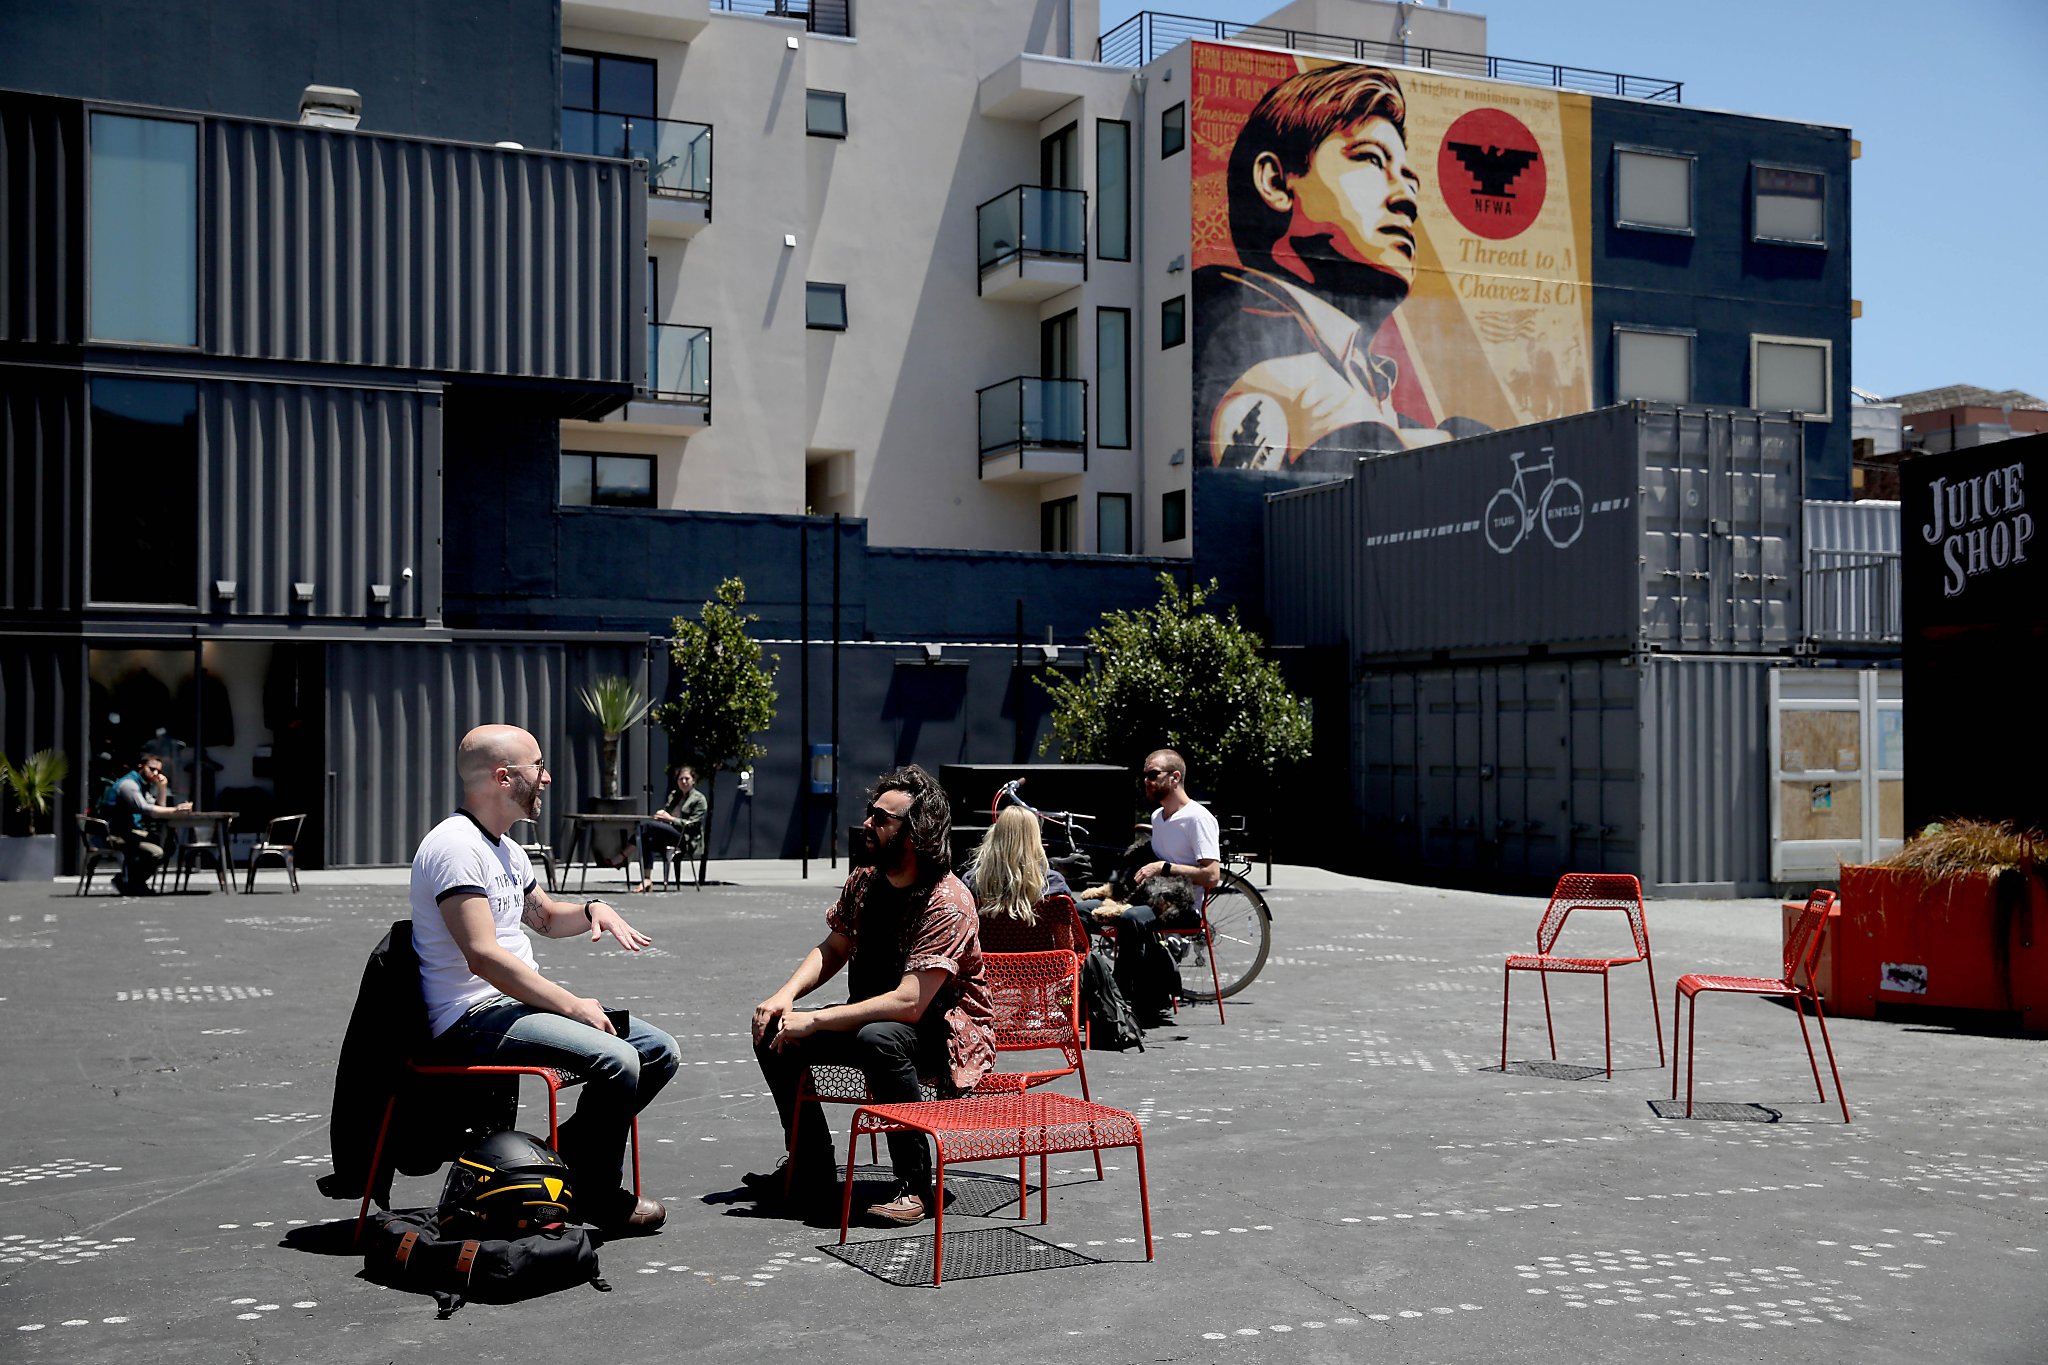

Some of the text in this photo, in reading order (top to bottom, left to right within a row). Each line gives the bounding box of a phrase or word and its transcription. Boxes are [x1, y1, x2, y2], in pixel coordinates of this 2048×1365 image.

[1192, 46, 1220, 72] FARM
[1222, 50, 1253, 76] BOARD
[1198, 73, 1210, 96] TO
[1215, 77, 1231, 99] FIX
[1408, 78, 1417, 93] A
[1420, 81, 1459, 98] higher
[1464, 87, 1520, 106] minimum
[1192, 95, 1250, 125] American
[1475, 198, 1512, 215] NFWA
[1459, 238, 1528, 268] Threat
[1536, 250, 1554, 269] to
[1533, 280, 1551, 305] Is
[1922, 461, 2025, 545] JUICE
[1943, 512, 2034, 598] SHOP
